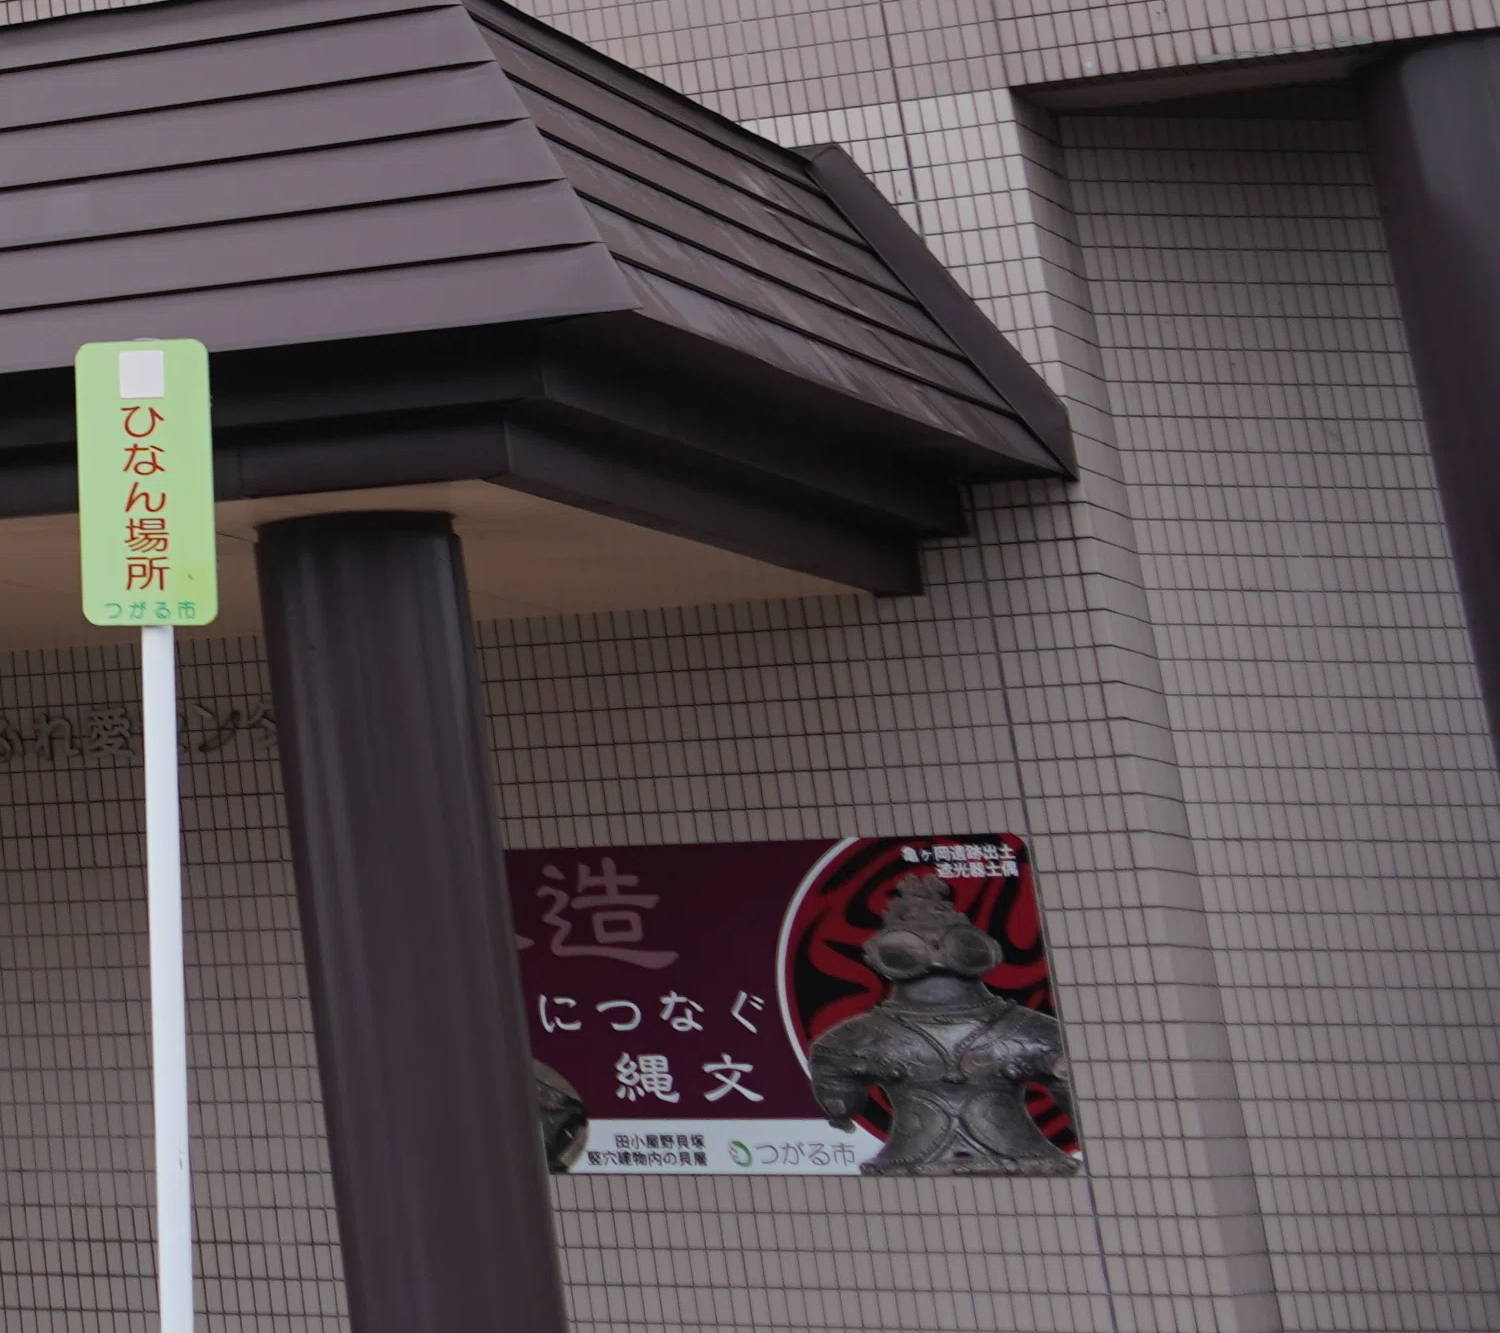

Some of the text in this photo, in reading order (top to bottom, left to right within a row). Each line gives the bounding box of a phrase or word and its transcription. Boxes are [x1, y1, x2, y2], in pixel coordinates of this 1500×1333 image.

[120, 405, 170, 591] ひなん場所
[104, 600, 196, 621] つがる市
[516, 856, 680, 969] 造
[538, 990, 765, 1034] につなぐ
[615, 1051, 765, 1104] 縄文
[614, 1134, 707, 1150] 田小屋野貝塚
[755, 1142, 856, 1166] つがる市
